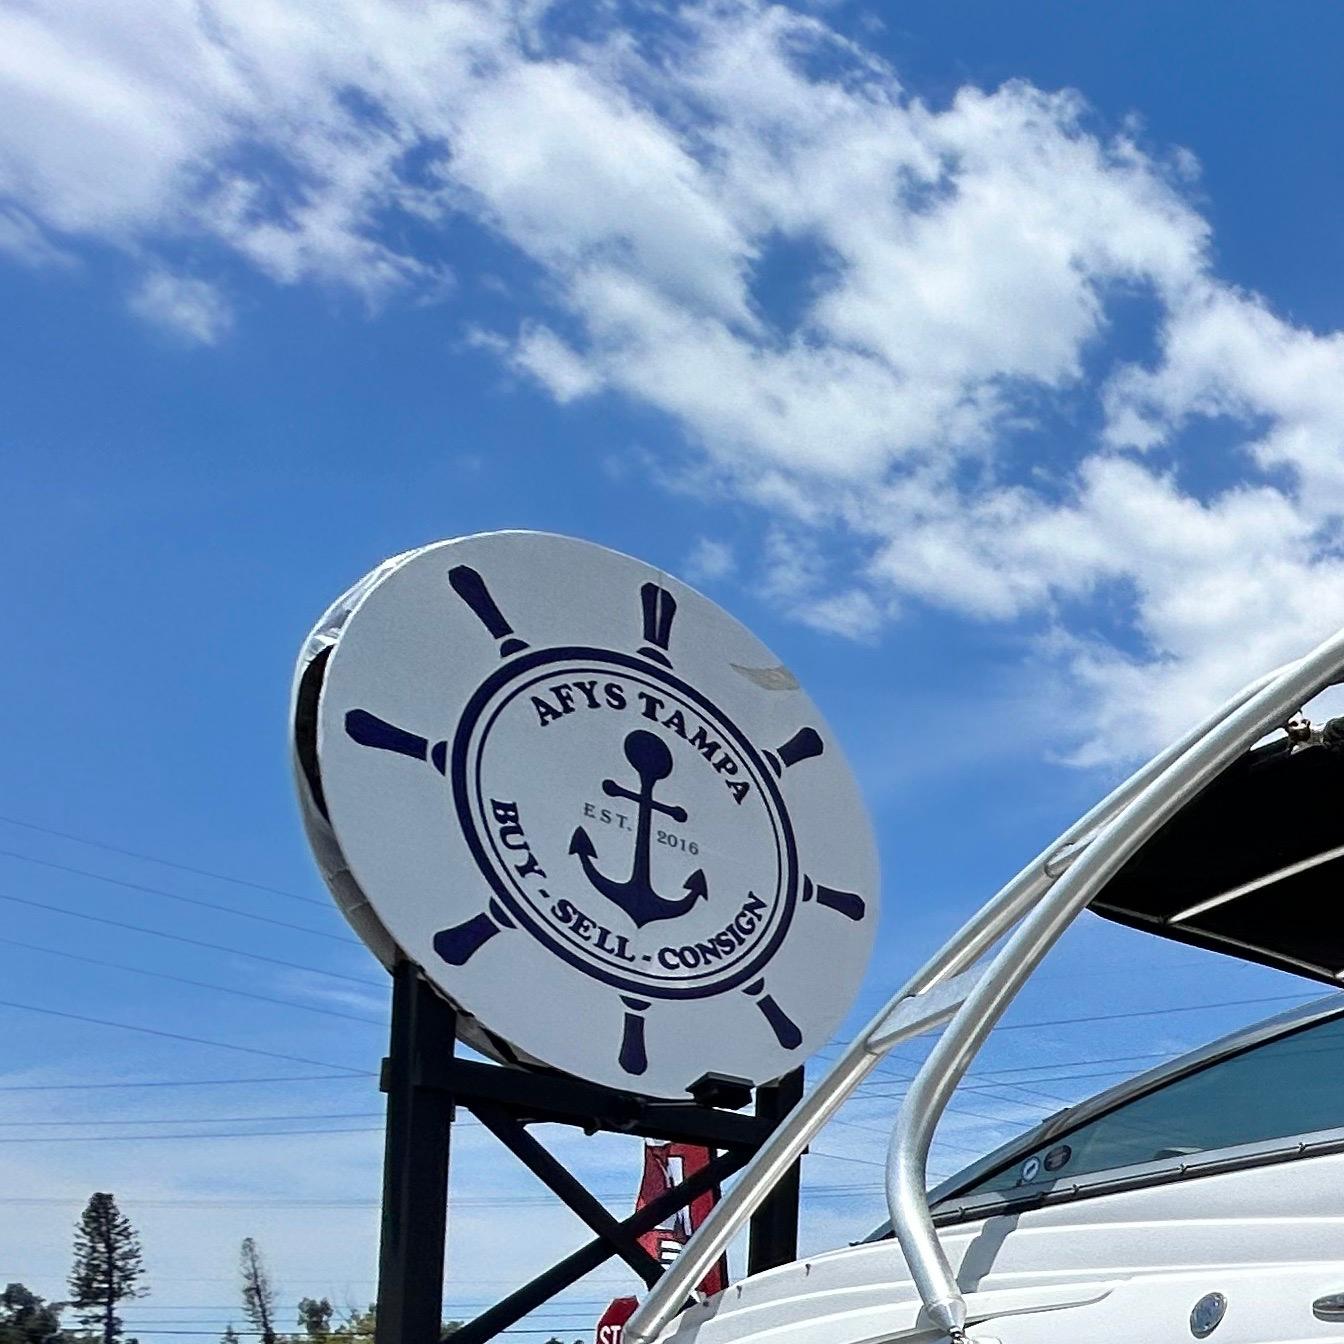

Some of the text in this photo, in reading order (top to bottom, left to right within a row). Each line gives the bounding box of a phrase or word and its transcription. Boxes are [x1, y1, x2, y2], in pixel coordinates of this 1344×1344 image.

[530, 680, 751, 806] AFYS TAMPA
[489, 798, 548, 879] BUY
[550, 898, 636, 963] SELL
[657, 890, 768, 971] CONSIGN
[583, 802, 700, 856] EST. 2016
